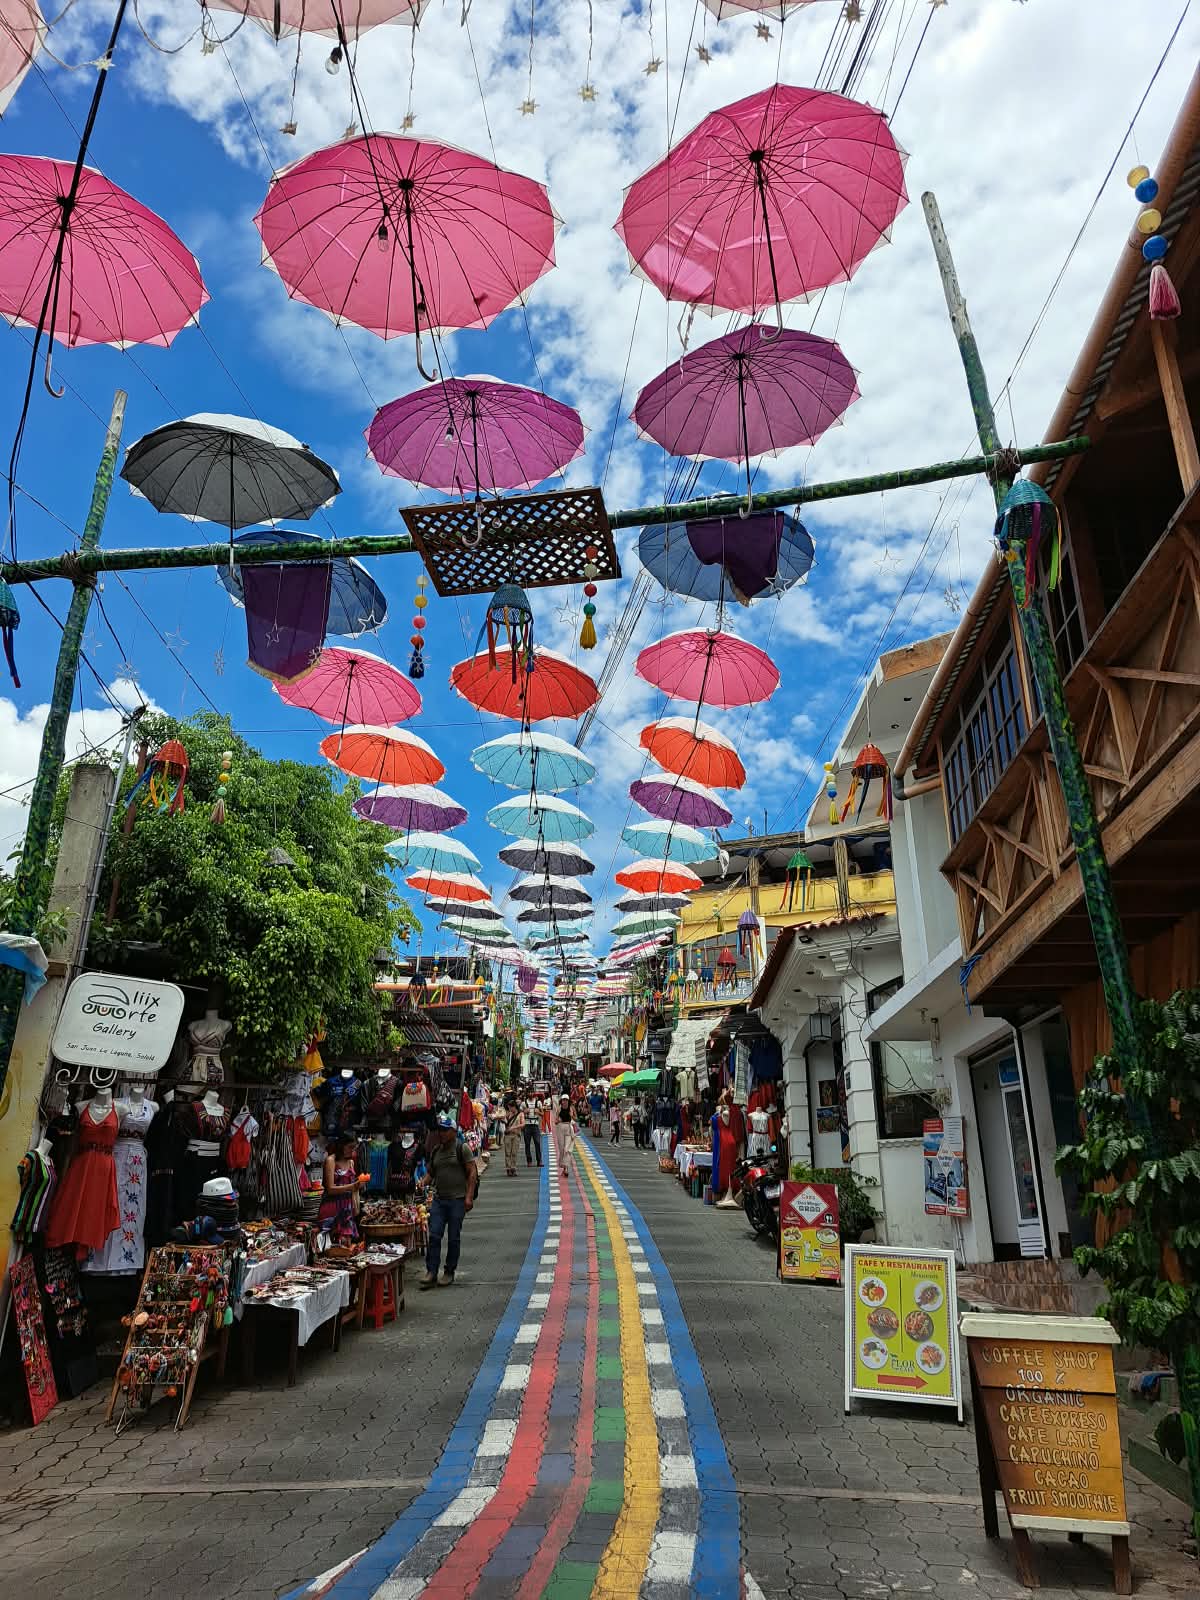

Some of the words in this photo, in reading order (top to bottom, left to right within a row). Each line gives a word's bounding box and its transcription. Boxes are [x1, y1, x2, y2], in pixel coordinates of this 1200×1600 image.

[92, 1022, 137, 1040] Gallery
[886, 1261, 943, 1272] RESTAURANTE
[982, 1347, 1046, 1367] COFFEE
[1053, 1348, 1099, 1370] SHOP
[1018, 1368, 1044, 1383] 100
[1005, 1383, 1085, 1408] ORGANIC
[1000, 1404, 1039, 1423] CAFE
[1041, 1408, 1108, 1431] EXPRESO
[1007, 1424, 1049, 1445] CAFE
[1056, 1430, 1101, 1449] LATE
[1008, 1444, 1100, 1472] CAPUCHINO
[1034, 1469, 1090, 1489] CACAO
[1008, 1488, 1047, 1507] FRUIT
[1050, 1489, 1120, 1514] SMOOTHIE
